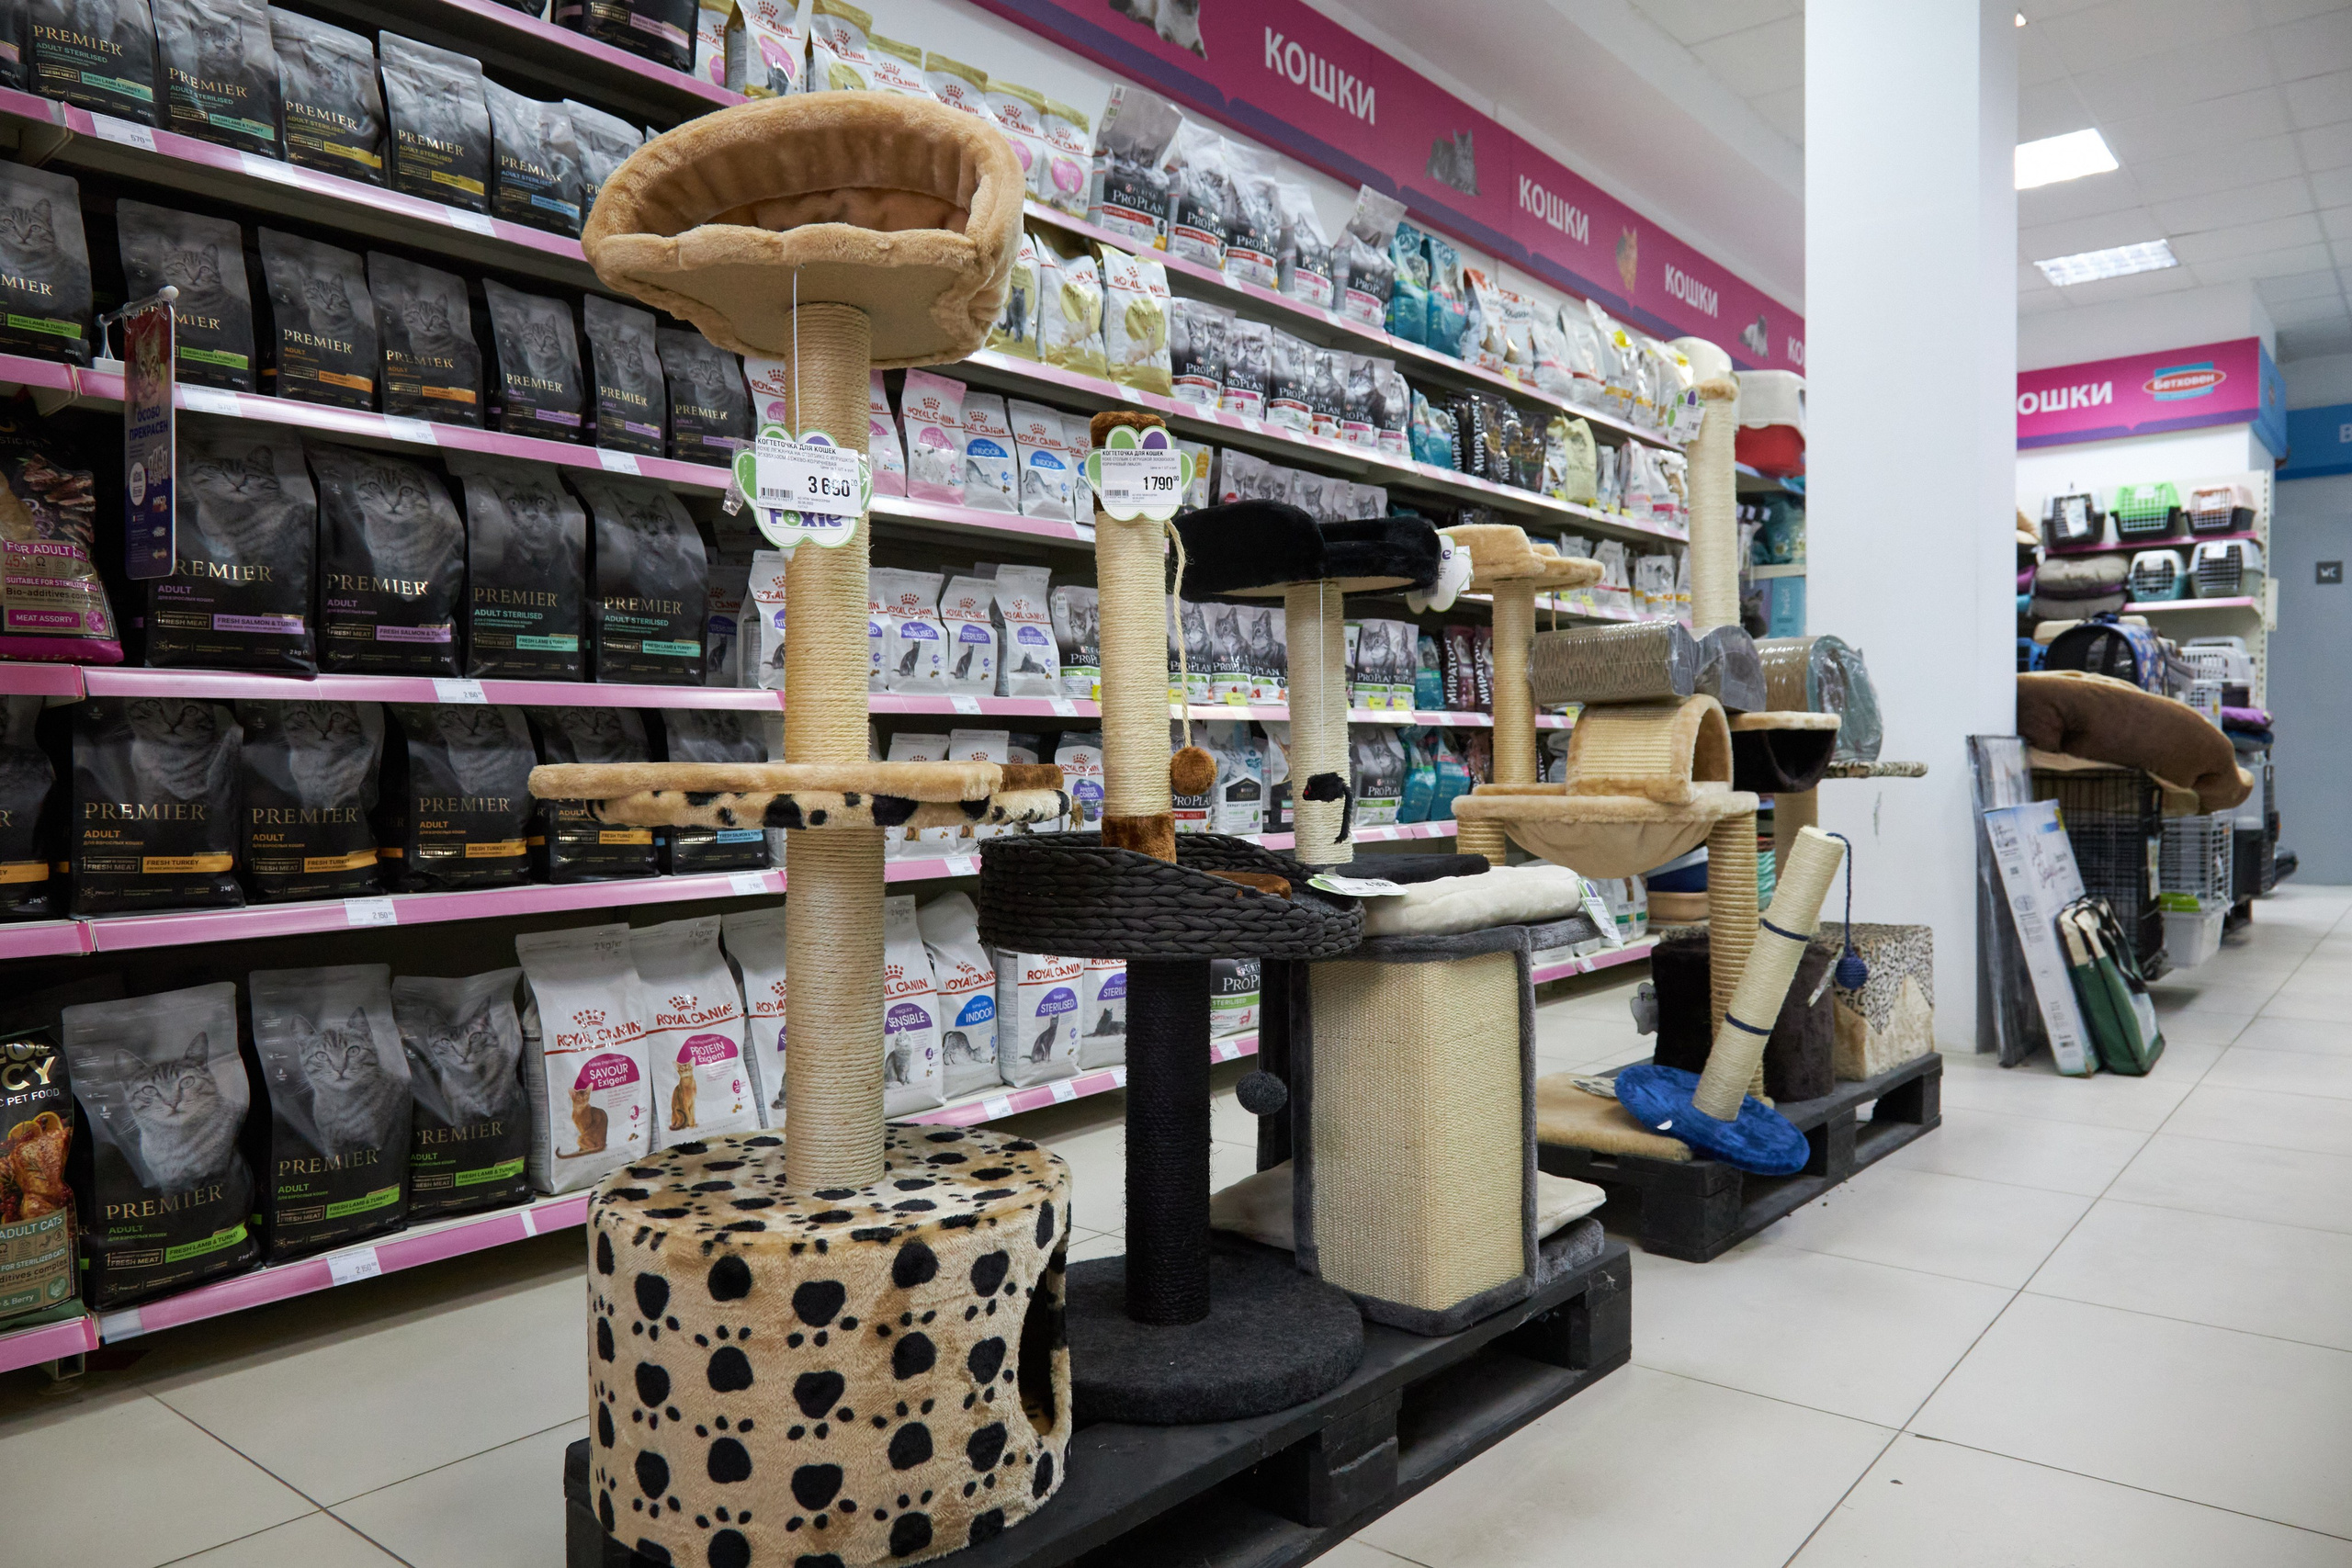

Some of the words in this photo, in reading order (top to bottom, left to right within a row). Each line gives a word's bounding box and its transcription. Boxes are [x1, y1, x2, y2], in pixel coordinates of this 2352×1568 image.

[33, 25, 123, 56] PREMIER
[36, 42, 63, 53] ADULT
[64, 47, 107, 63] STERILISED
[169, 67, 247, 97] PREMIER
[1265, 26, 1375, 126] КОШКИ
[170, 85, 192, 94] ADULT
[197, 92, 233, 105] STERILISED
[286, 100, 357, 130] PREMIER
[288, 116, 309, 125] ADULT
[311, 120, 345, 134] STERILISED
[130, 134, 145, 143] 570
[398, 129, 464, 157] PREMIER
[400, 144, 419, 153] ADULT
[420, 150, 452, 163] STERILISED
[501, 170, 520, 179] ADULT
[1520, 175, 1589, 246] КОШКИ
[1665, 263, 1718, 319] КОШКИ
[283, 328, 352, 355] PREMIER
[285, 347, 306, 355] ADULT
[386, 349, 454, 368] PREMIER
[506, 373, 563, 393] PREMIER
[2154, 374, 2214, 389] Бетховен
[600, 386, 648, 408] PREMIER
[2017, 380, 2112, 415] ОШКИ
[138, 407, 160, 423] ОСОБО
[675, 404, 728, 421] PREMIER
[129, 420, 168, 441] ПРЕКРАСЕН
[757, 437, 797, 449] КОГТЕТОЧКА
[814, 446, 836, 455] КОШЕК
[1039, 437, 1061, 447] CANIN
[971, 446, 1000, 456] INDOOR
[808, 476, 818, 493] 3
[1144, 476, 1148, 490] 1
[1151, 476, 1172, 491] 790
[6, 542, 28, 554] FOR
[33, 545, 70, 556] ADULT
[5, 555, 28, 568] 45%
[2321, 566, 2336, 578] WC
[6, 577, 39, 585] SUITABLE
[327, 574, 428, 595] PREMIER
[6, 588, 70, 598] Bio-additives
[158, 585, 192, 594] ADULT
[474, 587, 558, 608] PREMIER
[327, 599, 357, 607] ADULT
[605, 597, 682, 615] PREMIER
[475, 609, 501, 617] ADULT
[503, 611, 543, 619] STERILISED
[635, 617, 669, 626] STERILISED
[962, 631, 987, 641] STERILISED
[85, 802, 206, 820] PREMIER
[419, 797, 510, 813] PREMIER
[252, 807, 358, 824] PREMIER
[420, 820, 448, 829] ADULT
[85, 829, 120, 838] ADULT
[253, 833, 285, 841] ADULT
[1027, 967, 1053, 980] ROYAL
[1055, 963, 1081, 976] CANIN
[897, 978, 929, 993] CANIN
[1223, 977, 1250, 991] PRO
[1041, 1001, 1075, 1013] STERILISED
[1213, 998, 1247, 1006] STERILISED
[656, 1014, 689, 1026] ROYAL
[691, 1005, 733, 1023] CANIN
[888, 1012, 925, 1028] SENSIBLE
[557, 1031, 593, 1047] ROYAL
[597, 1021, 641, 1041] CANIN
[690, 1043, 725, 1055] PROTEIN
[698, 1051, 726, 1063] Exigent
[589, 1063, 628, 1080] SAVOUR
[598, 1076, 627, 1089] Exigent
[7, 1095, 28, 1107] PET
[31, 1088, 60, 1100] FOOD
[278, 1148, 379, 1178] PREMIER
[458, 1172, 477, 1180] FRESH
[478, 1170, 492, 1179] LAMB
[277, 1183, 310, 1194] ADULT
[105, 1184, 222, 1220] PREMIER
[329, 1203, 348, 1212] FRESH
[349, 1200, 365, 1209] LAMB
[40, 1214, 62, 1232] CATS
[280, 1214, 300, 1223] FRESH
[108, 1225, 143, 1235] ADULT
[169, 1246, 191, 1256] FRESH
[193, 1242, 211, 1251] LAMB
[1, 1263, 15, 1271] FOR
[16, 1254, 51, 1269] STERILIZED
[52, 1247, 65, 1258] CATS
[111, 1258, 136, 1267] FRESH
[34, 1258, 67, 1278] complex
[3, 1298, 9, 1306] &
[11, 1293, 34, 1306] Berry
